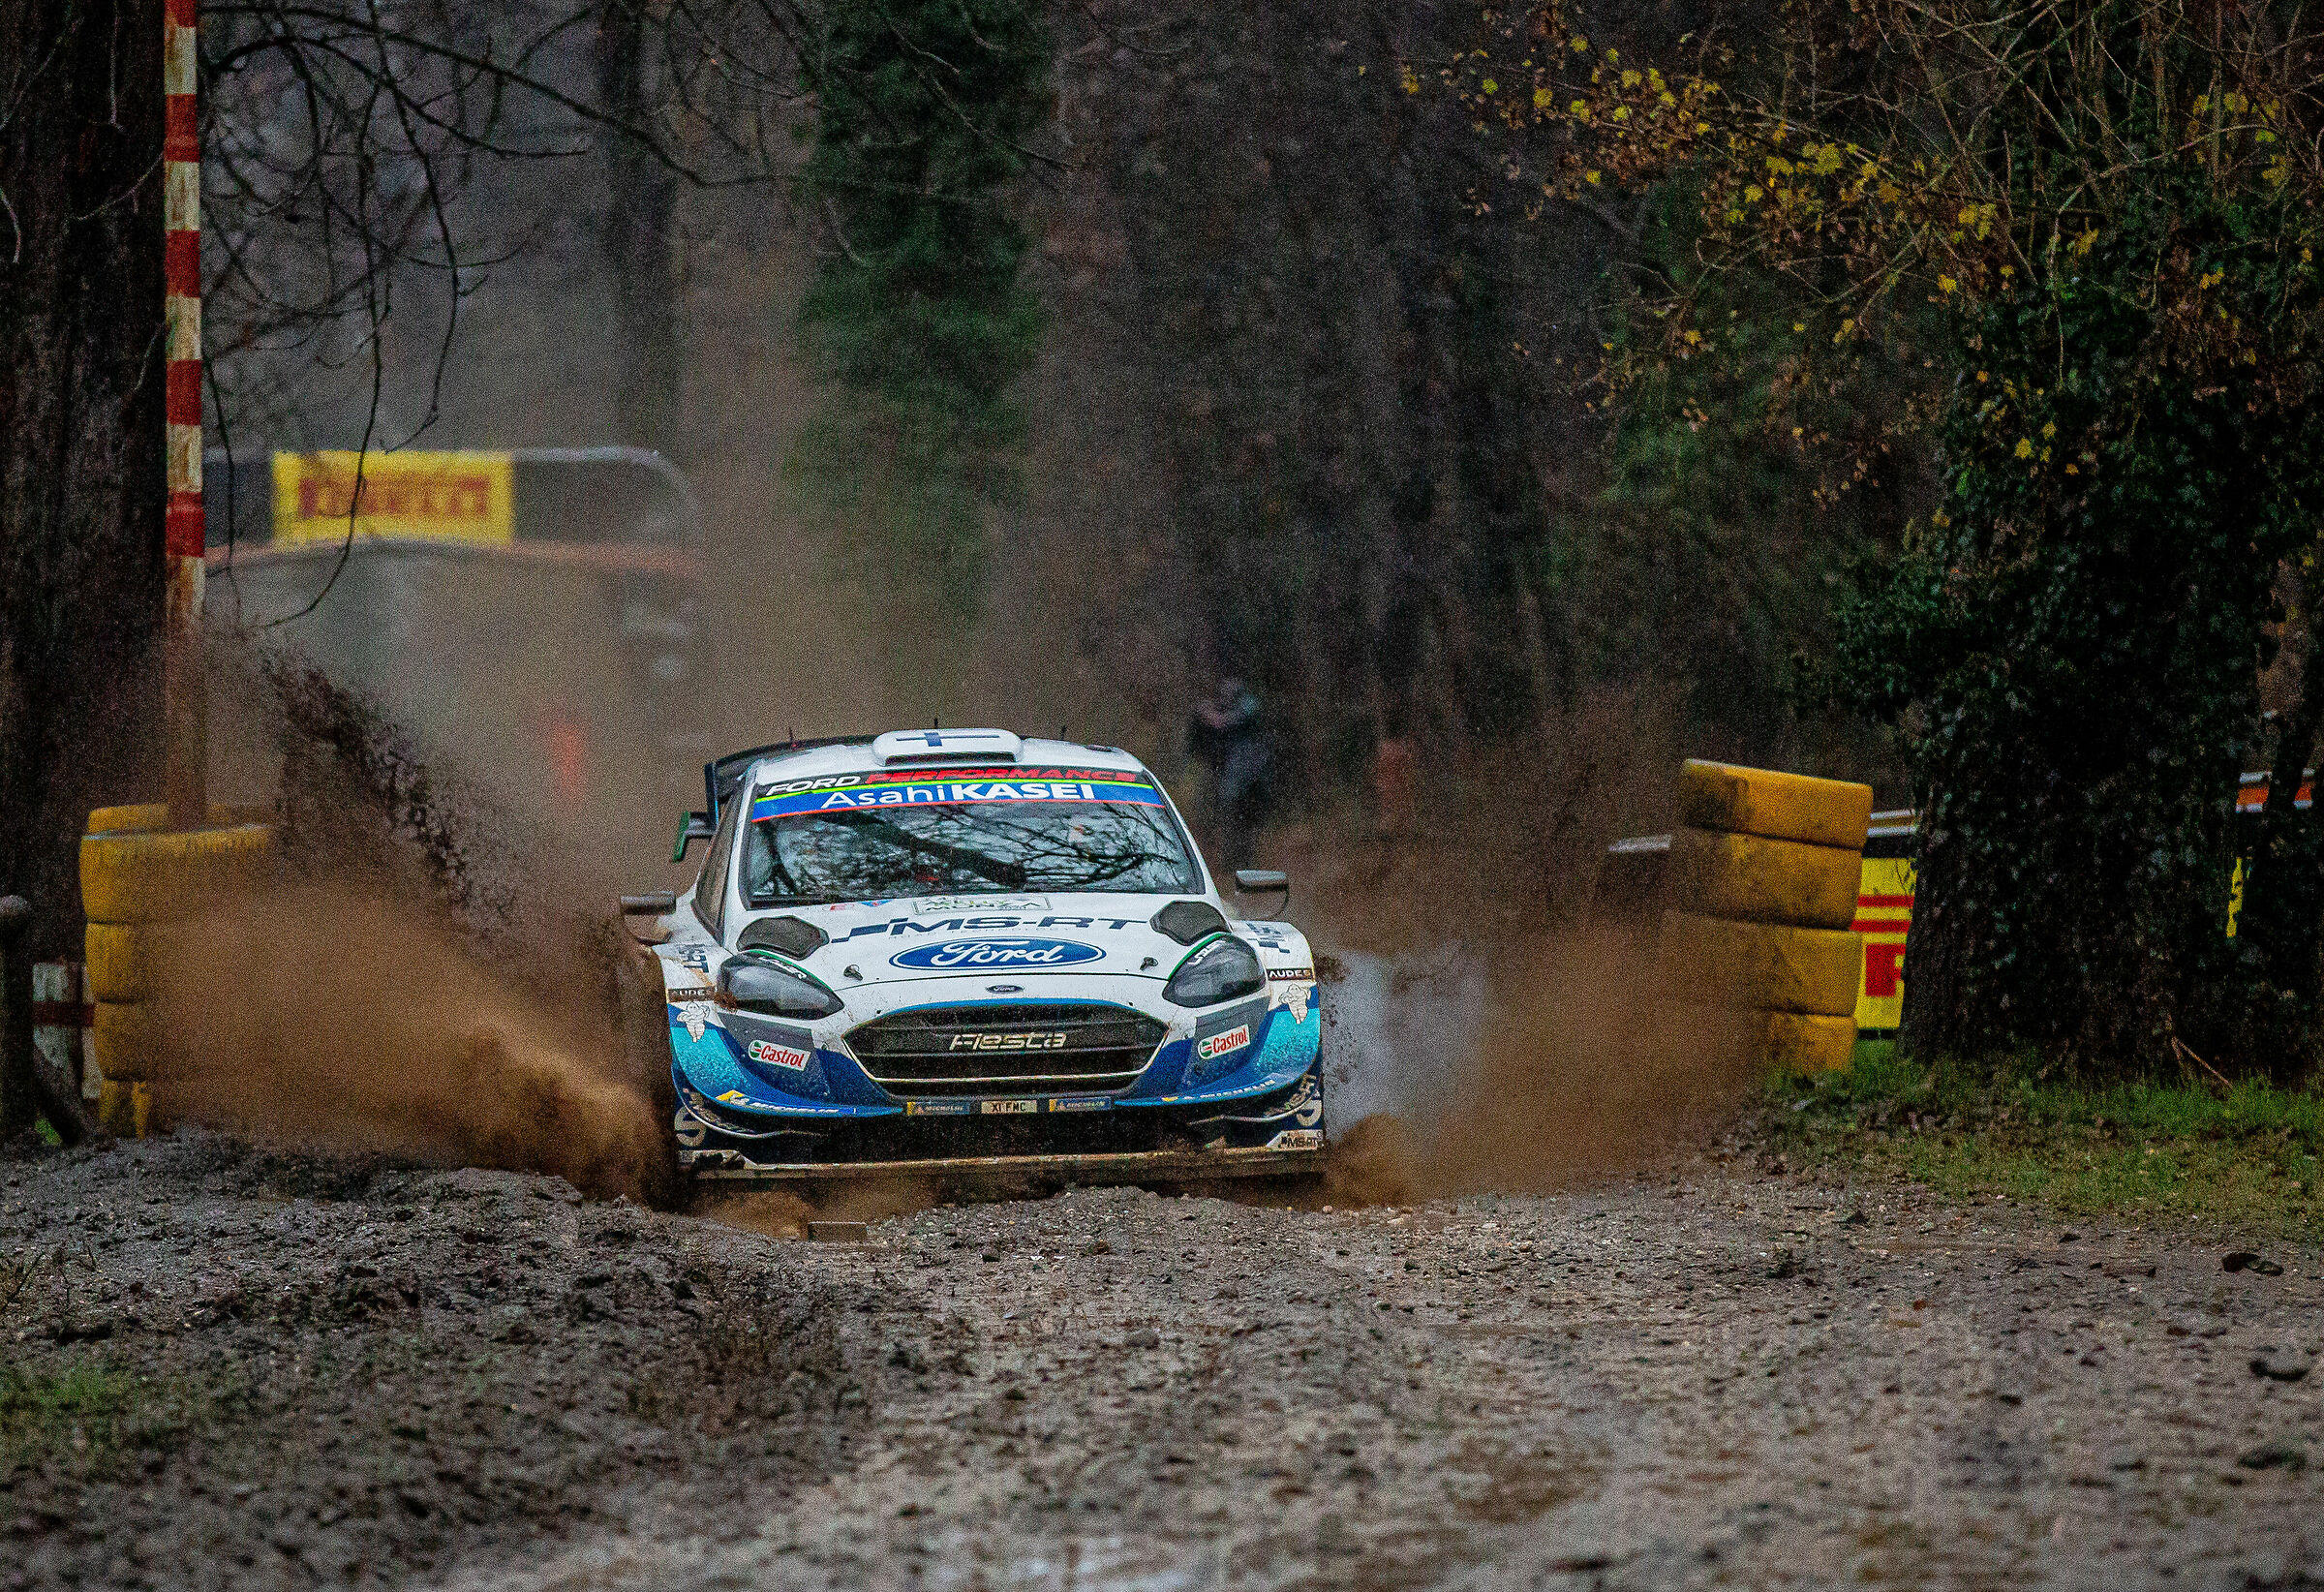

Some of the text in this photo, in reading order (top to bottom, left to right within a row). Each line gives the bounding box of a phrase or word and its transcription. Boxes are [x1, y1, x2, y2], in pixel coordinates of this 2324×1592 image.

[765, 769, 1136, 796] FORD PERFORMANCE
[931, 940, 1064, 966] Ford
[949, 1032, 1067, 1051] Fiesta
[1212, 1028, 1249, 1054] Castrol
[760, 1045, 806, 1068] Castrol
